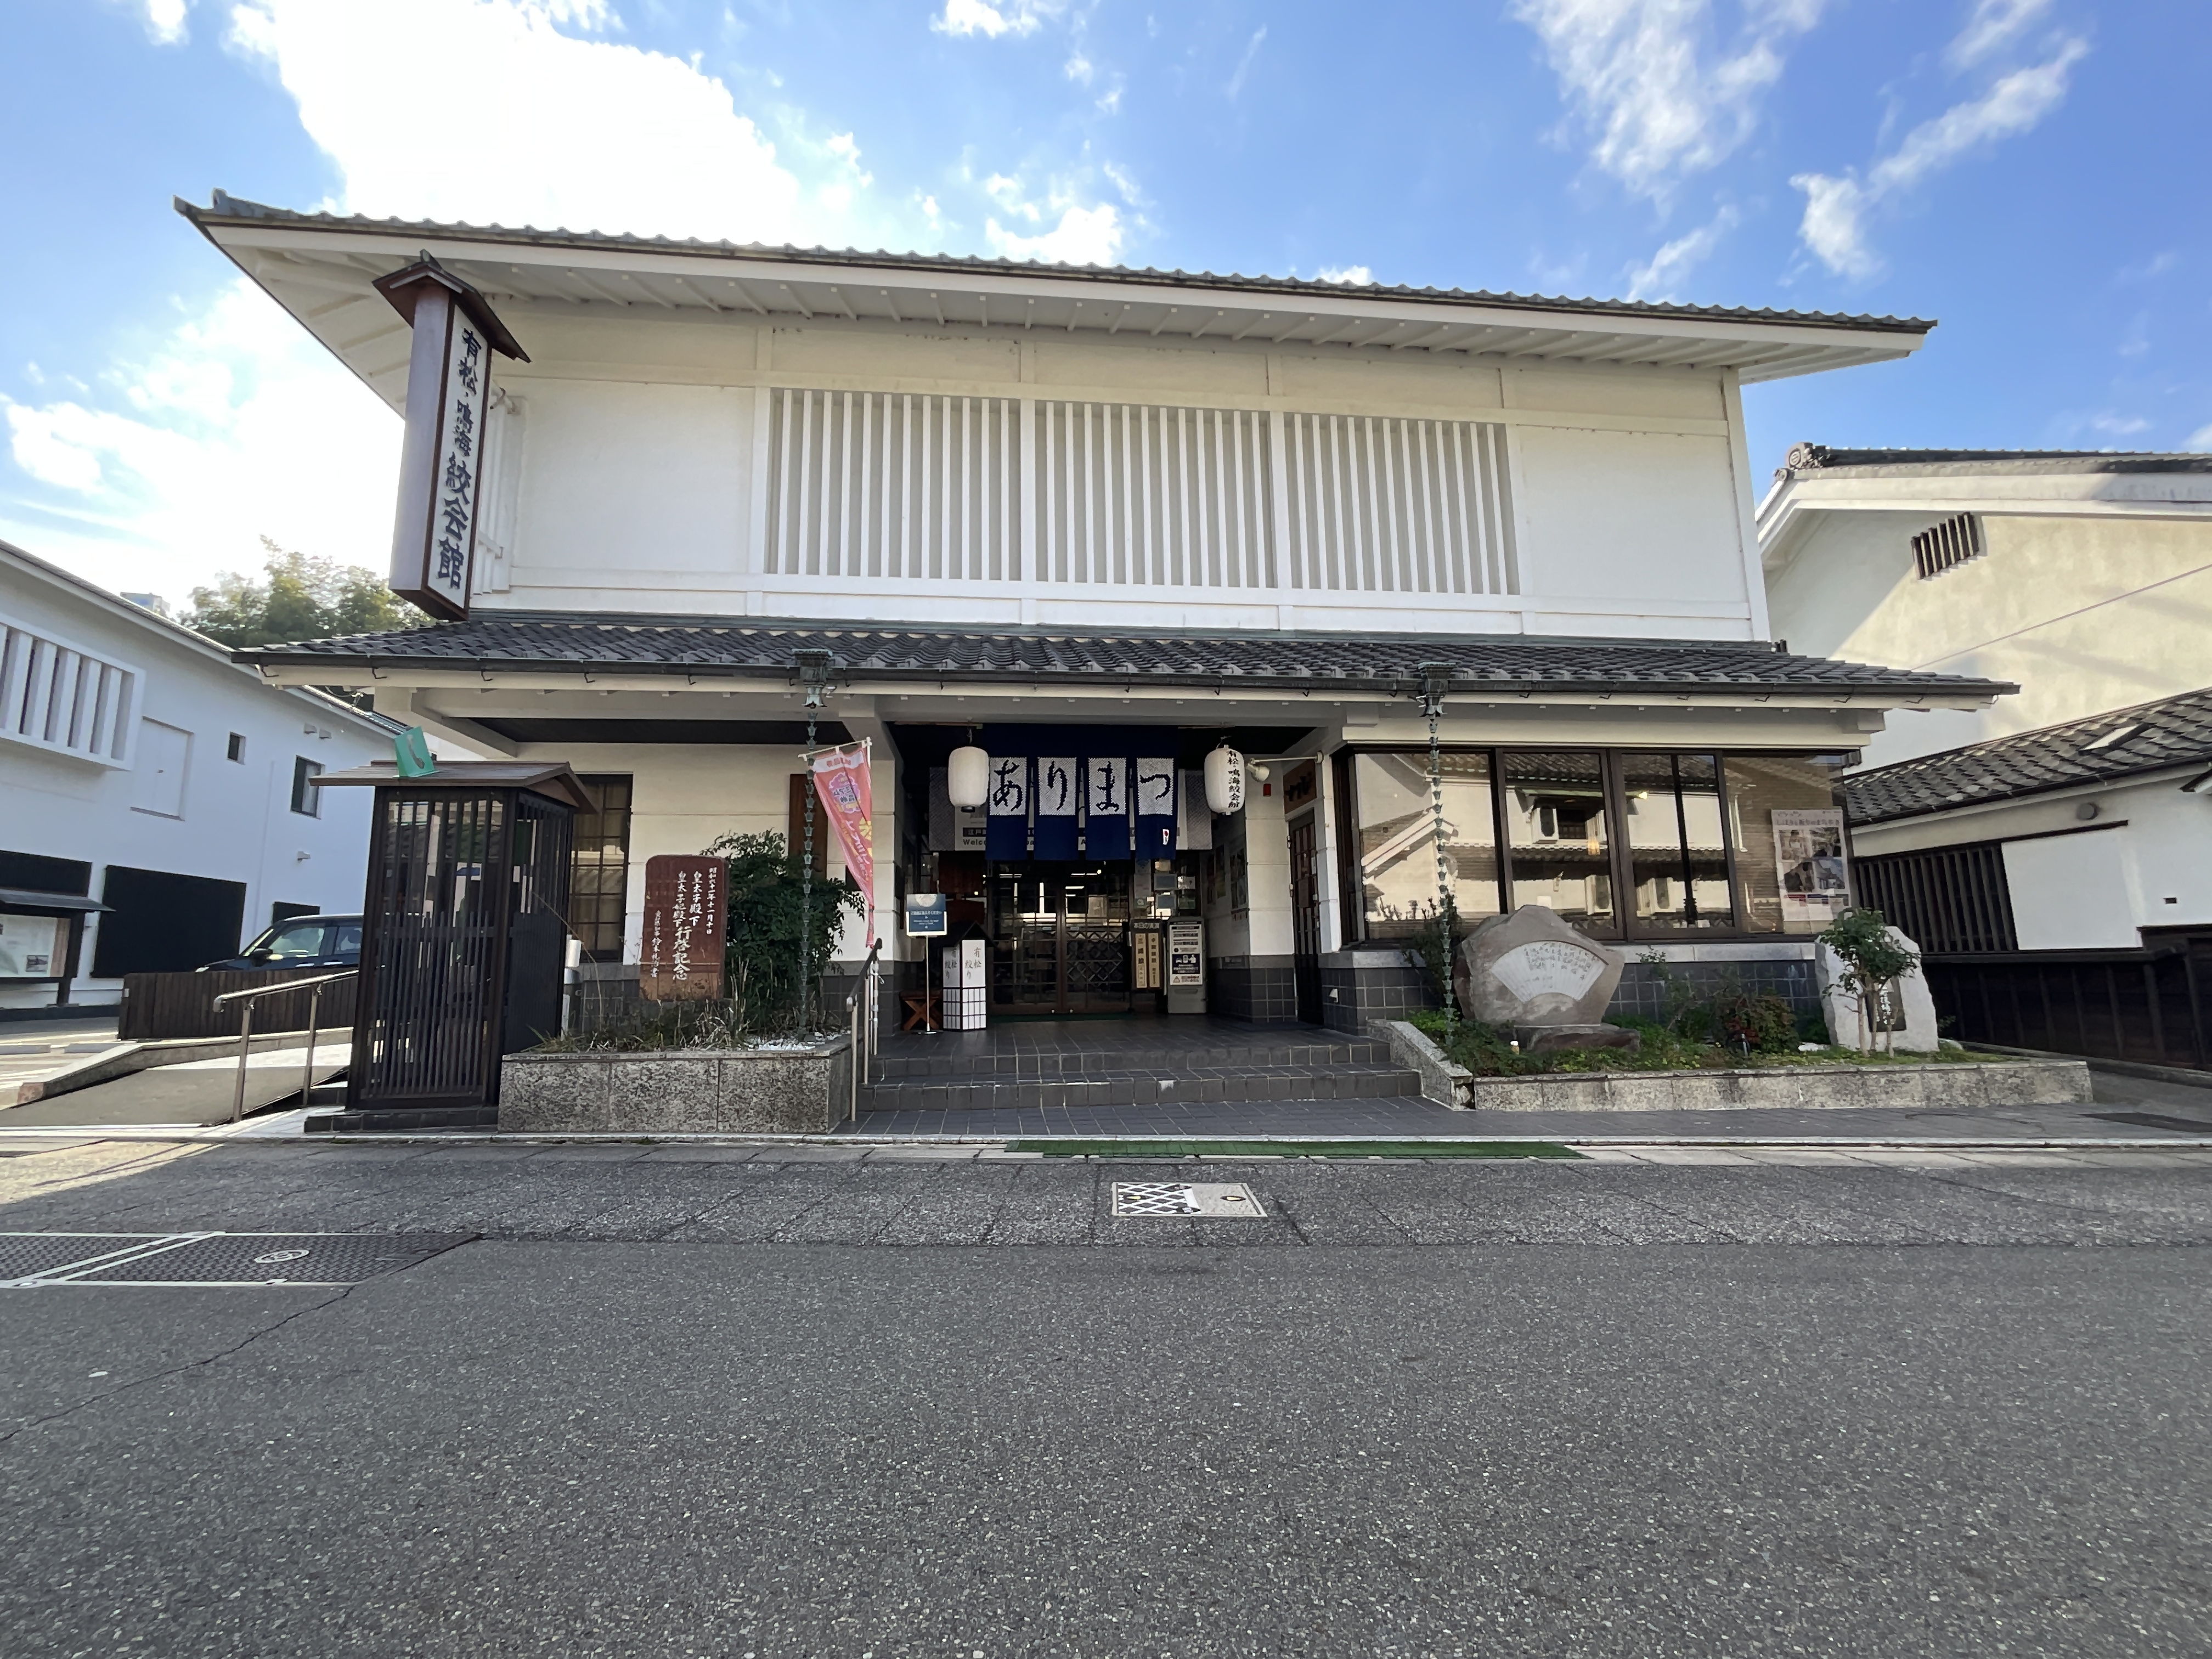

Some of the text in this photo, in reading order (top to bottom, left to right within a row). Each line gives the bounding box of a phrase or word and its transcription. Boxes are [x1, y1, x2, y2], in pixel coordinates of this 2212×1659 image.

[992, 759, 1171, 812] ありまつ
[689, 871, 703, 926] 皇太子殿下
[974, 947, 981, 968] 有松
